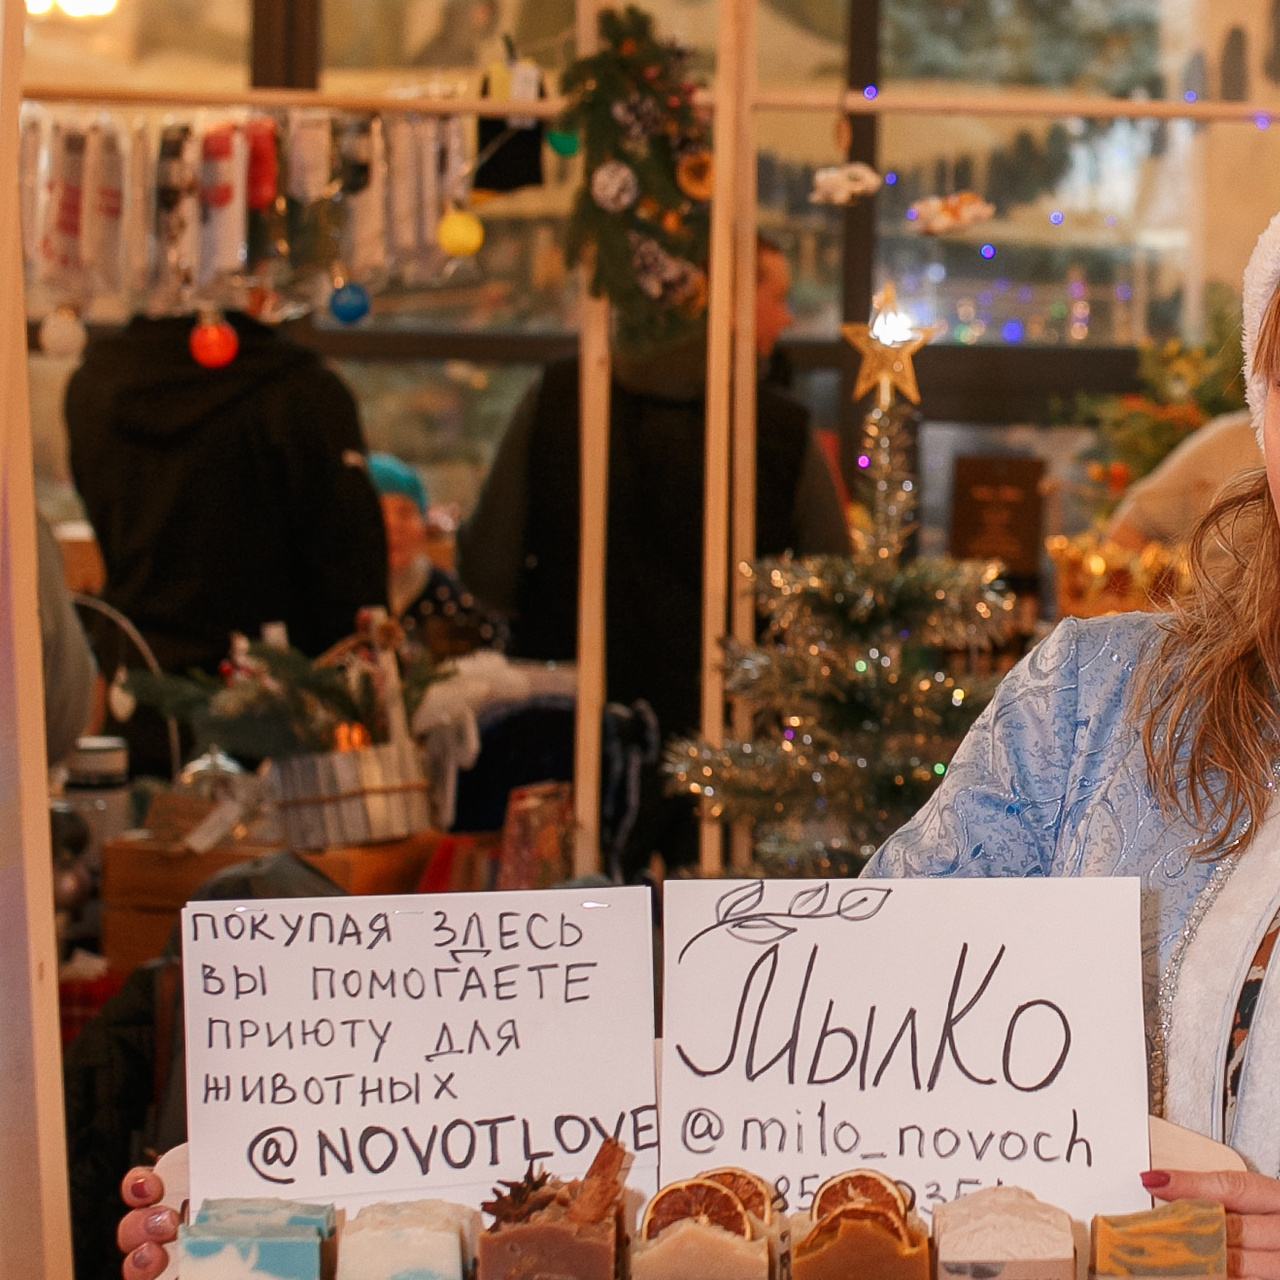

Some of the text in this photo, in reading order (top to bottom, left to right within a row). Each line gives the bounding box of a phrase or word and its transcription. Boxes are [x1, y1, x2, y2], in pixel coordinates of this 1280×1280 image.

[837, 514, 898, 564] 1200
[191, 911, 583, 962] ПОКУПАЯ ЗДЕСЬ
[201, 962, 598, 1003] ВЫ ПОМОГАЕТЕ
[207, 1018, 521, 1062] ПРИЮТУ ДЛЯ
[203, 1071, 458, 1106] ЖИВОТНЫХ
[248, 1103, 659, 1185] @NOVOTLOVE
